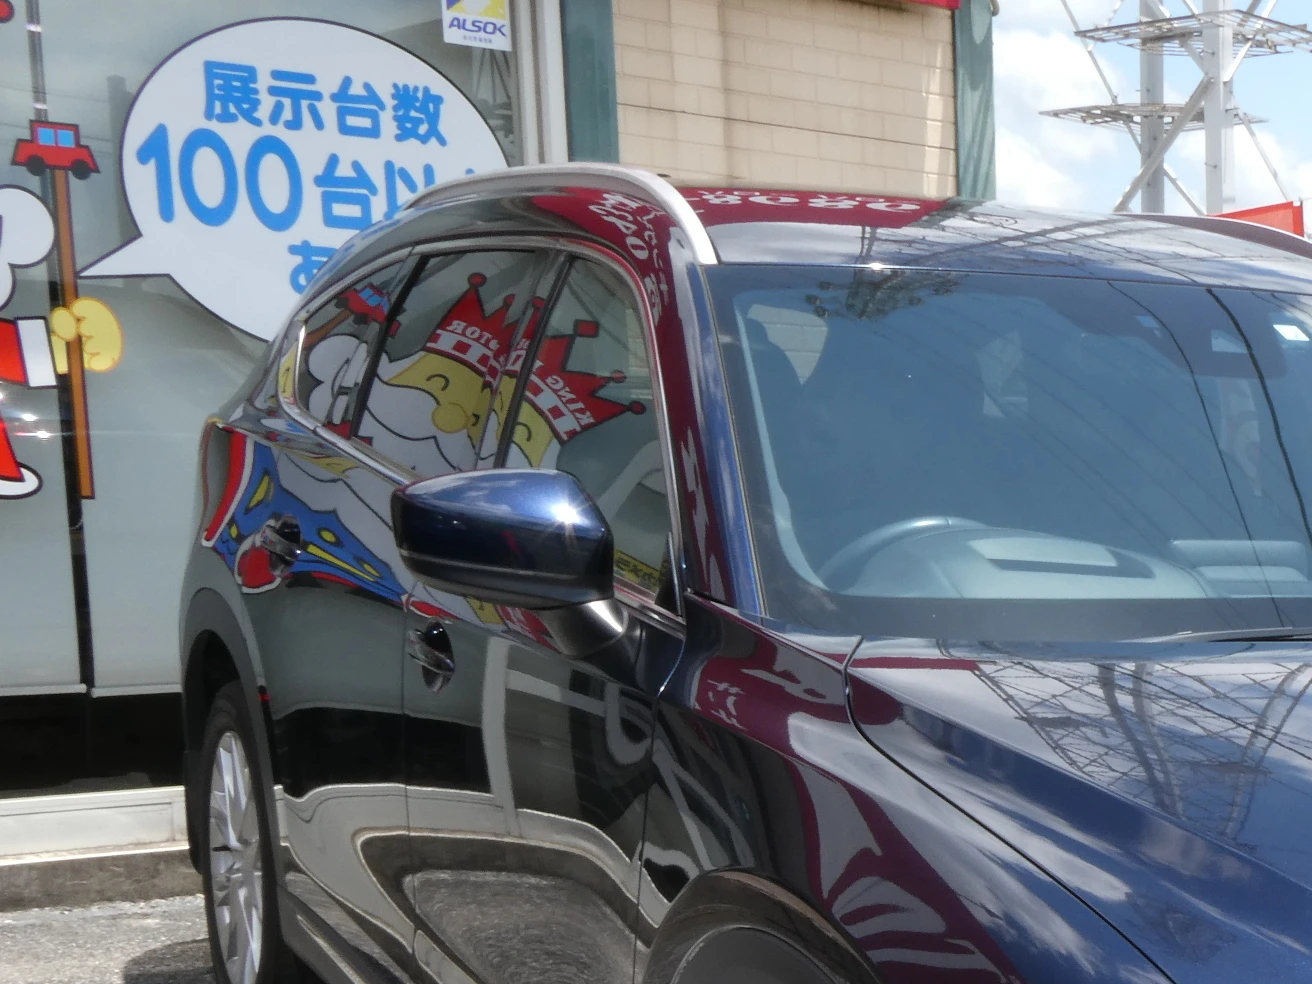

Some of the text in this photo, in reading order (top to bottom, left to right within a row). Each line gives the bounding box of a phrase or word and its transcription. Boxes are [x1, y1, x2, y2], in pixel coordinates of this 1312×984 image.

[449, 16, 507, 38] ALSOK
[203, 60, 447, 146] 展示台数
[136, 123, 476, 232] 100台以
